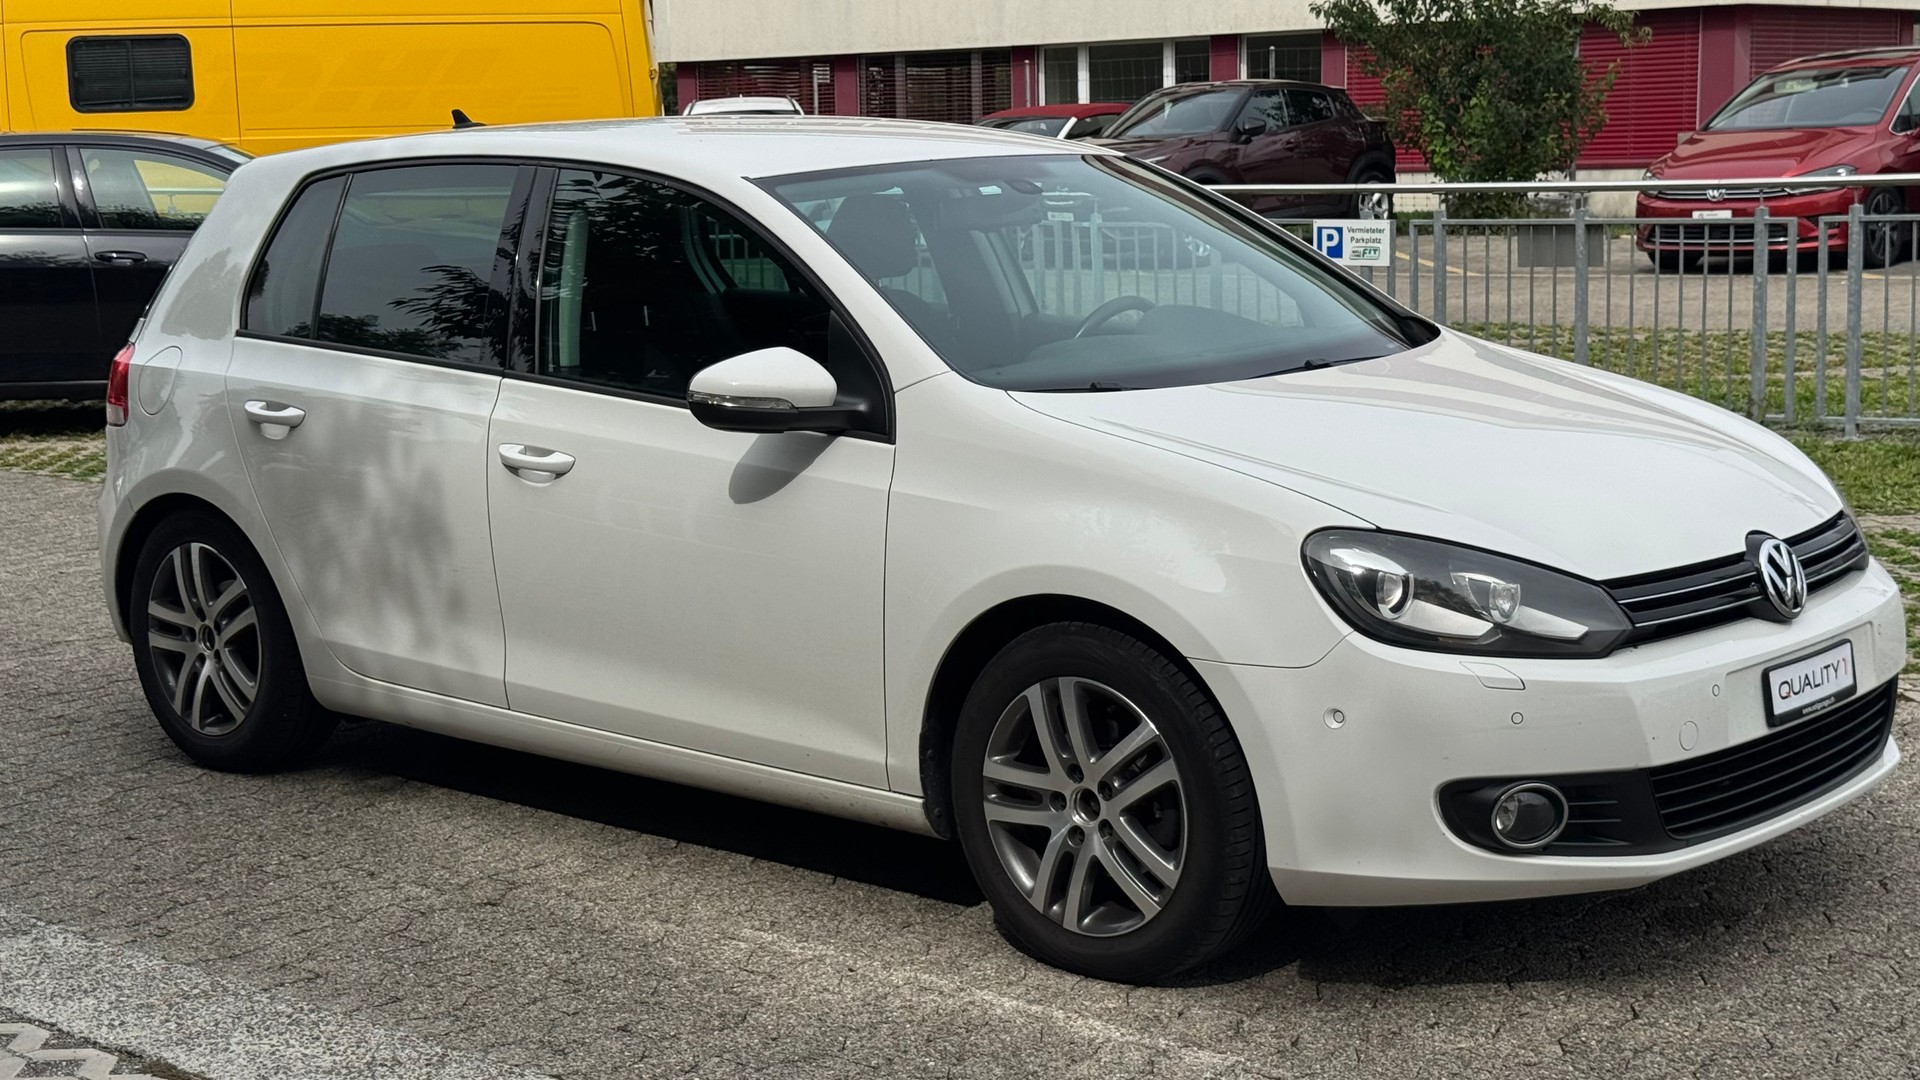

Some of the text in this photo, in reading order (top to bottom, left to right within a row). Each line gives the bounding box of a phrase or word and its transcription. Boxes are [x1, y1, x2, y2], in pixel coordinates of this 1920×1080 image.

[1346, 226, 1386, 234] Vermieteter
[1322, 228, 1339, 257] P
[1350, 236, 1382, 245] Parkplatz
[1362, 248, 1378, 258] FIT
